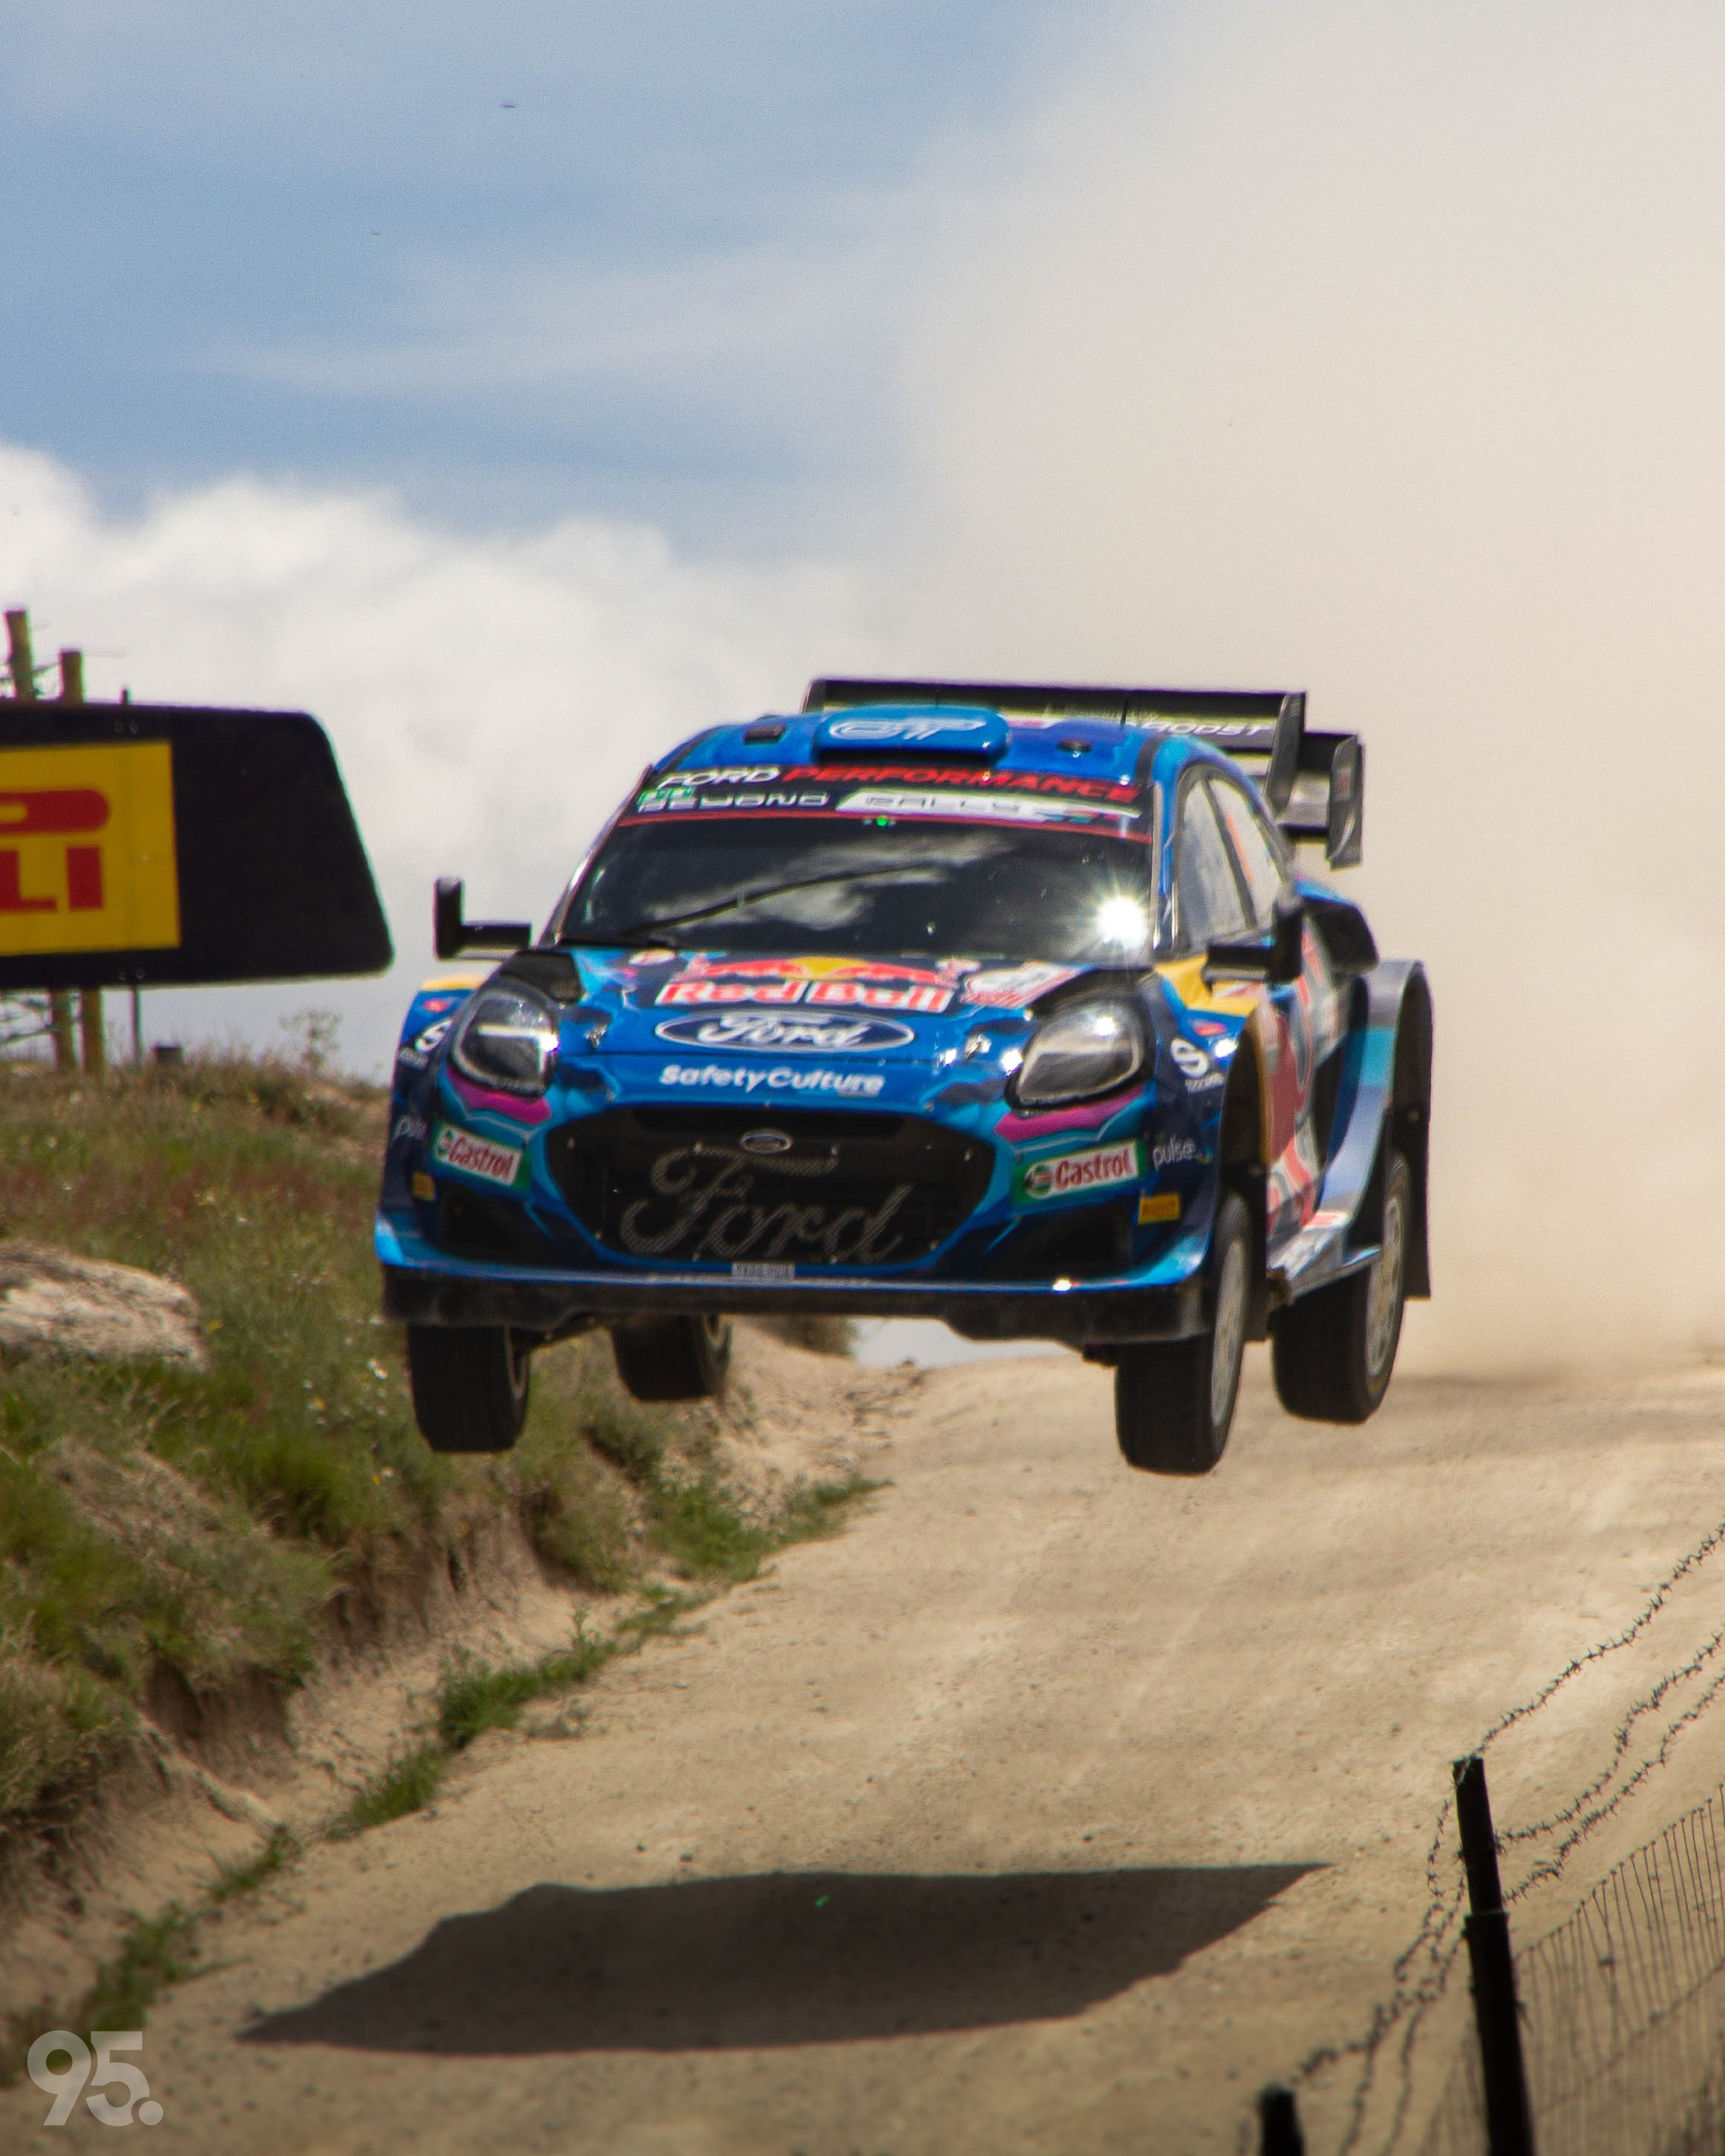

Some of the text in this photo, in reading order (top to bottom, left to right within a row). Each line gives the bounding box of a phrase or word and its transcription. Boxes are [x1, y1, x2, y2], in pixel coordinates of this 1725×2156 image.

[656, 765, 1140, 803] FORD PERFORMANCE
[656, 981, 955, 1012] Red Bull
[698, 1013, 871, 1045] Ford
[660, 1065, 885, 1095] SafetyCulture
[449, 1135, 513, 1178] Castrol
[1054, 1147, 1133, 1190] Castrol
[620, 1147, 914, 1262] Ford
